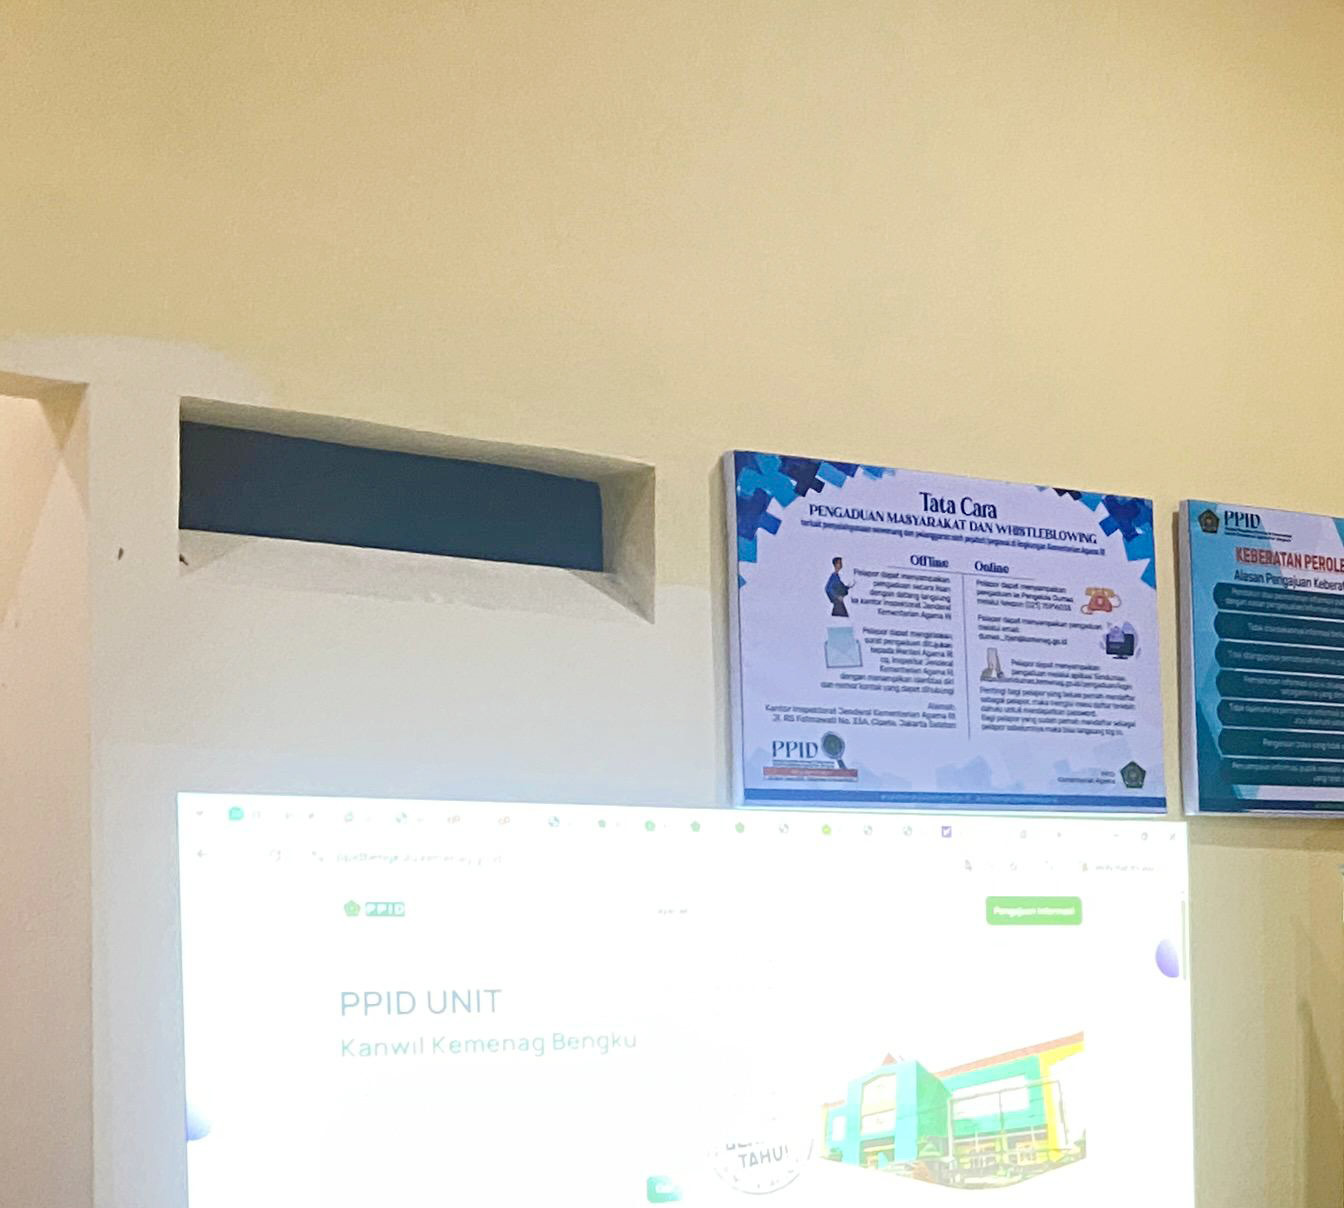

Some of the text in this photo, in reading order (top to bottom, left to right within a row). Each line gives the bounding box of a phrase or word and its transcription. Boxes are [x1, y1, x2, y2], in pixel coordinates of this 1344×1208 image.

[919, 491, 998, 520] Tata Cara
[808, 504, 885, 523] PENGADUAN
[886, 511, 967, 532] MASYARAKAT
[968, 519, 996, 535] DAN
[995, 522, 1098, 545] WHISTLEBLOWING
[1224, 510, 1261, 529] PPID
[974, 560, 1010, 575] Online
[1235, 546, 1302, 568] KEBERATAN
[1234, 569, 1265, 583] Alasan
[1266, 572, 1312, 590] Pengajuan
[771, 739, 819, 759] PPID
[364, 902, 406, 916] PPID
[340, 989, 503, 1017] PPID UNIT
[341, 1035, 425, 1058] Kanwil
[432, 1034, 546, 1058] Kemenag
